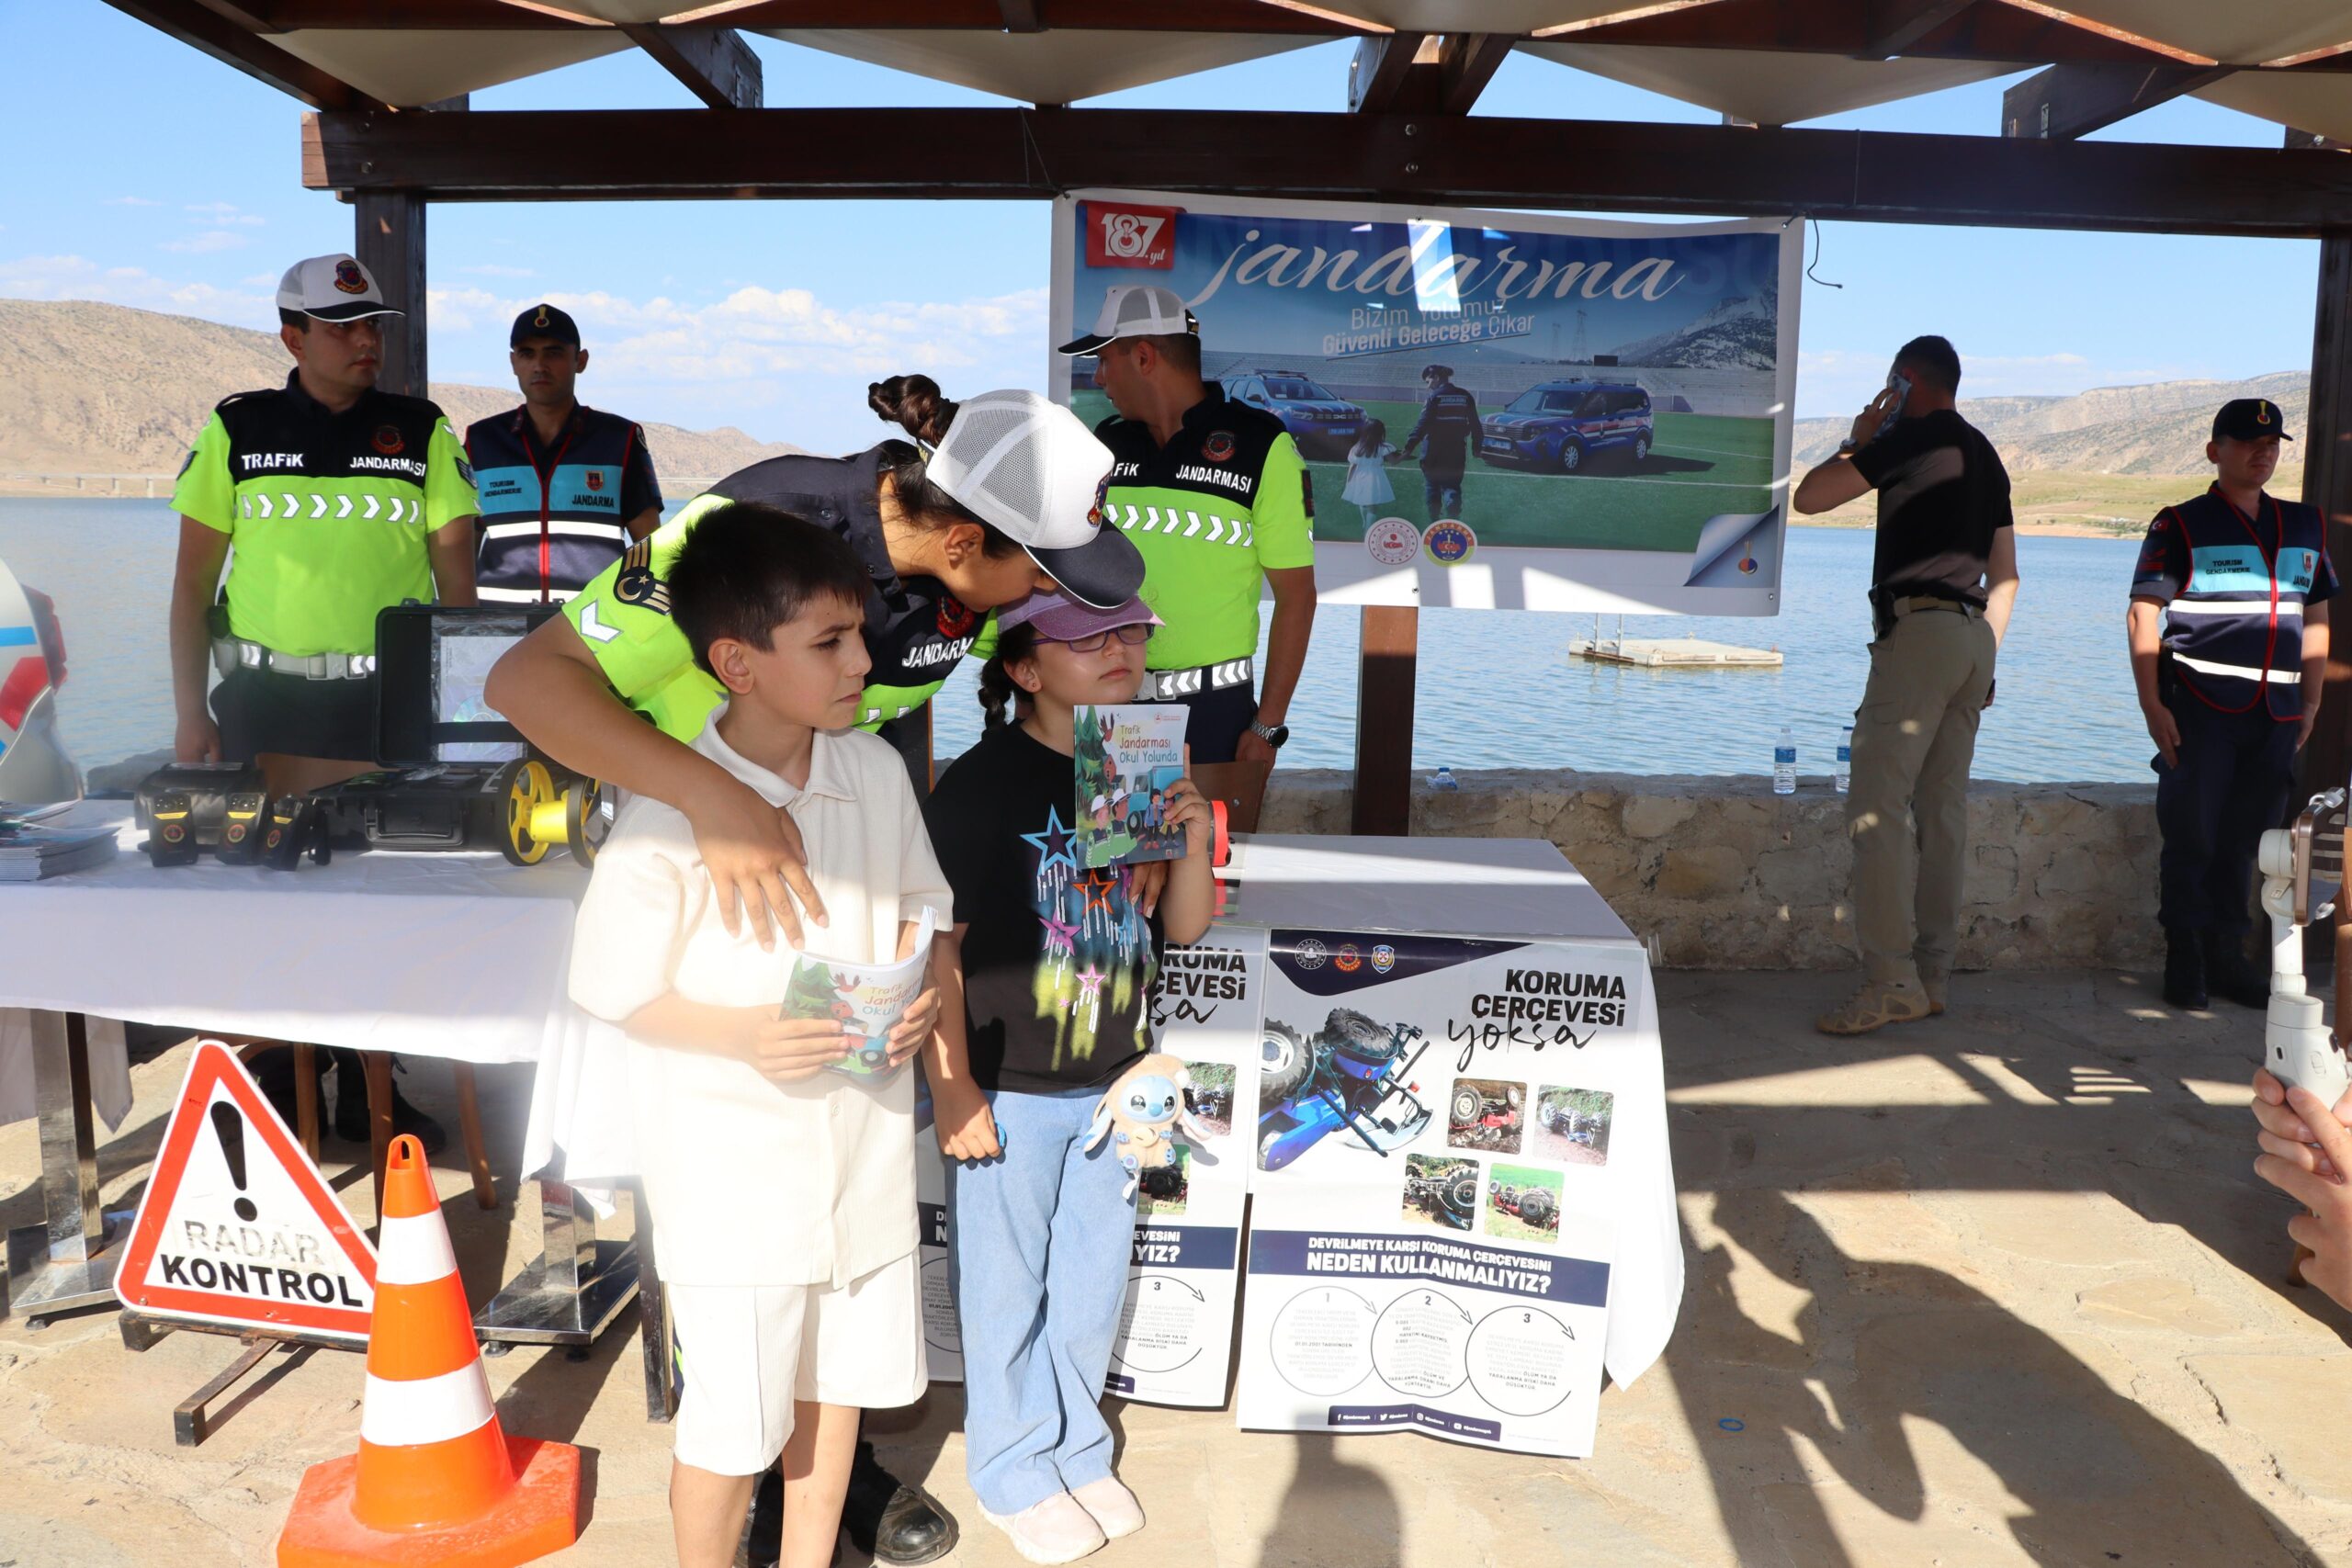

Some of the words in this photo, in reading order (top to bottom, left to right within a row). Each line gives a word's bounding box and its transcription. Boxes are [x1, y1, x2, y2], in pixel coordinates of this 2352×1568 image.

[1186, 220, 1685, 308] jandarma
[1351, 305, 1408, 330] Bizim
[1420, 299, 1508, 321] Yolumuz
[1323, 330, 1391, 355] Güvenli
[1398, 319, 1481, 346] Geleceğe
[1488, 313, 1535, 339] Çıkar
[349, 457, 426, 477] JANDARMASI
[1175, 464, 1252, 493] JANDARMASI
[571, 494, 615, 507] JANDARMA
[1119, 737, 1171, 749] Jandarması
[1120, 725, 1141, 735] Trafik
[1119, 751, 1139, 763] Okul
[1143, 750, 1178, 762] Yolunda
[1163, 943, 1246, 973] RUMA
[1505, 969, 1626, 999] KORUMA
[863, 1003, 897, 1015] Okul
[1471, 994, 1625, 1026] ÇERÇEVESİ
[1448, 1010, 1597, 1073] yoksa
[184, 1220, 325, 1266] RADAR
[1308, 1237, 1384, 1250] DEVRİLMEYE
[1385, 1239, 1420, 1253] KARŞI
[1422, 1241, 1471, 1260] KORUMA
[1473, 1250, 1552, 1272] ÇERÇEVESİNİ
[160, 1254, 364, 1307] KONTROL
[1154, 1281, 1161, 1292] 3
[1306, 1252, 1376, 1273] NEDEN
[1380, 1254, 1552, 1293] KULLANMALIYIZ?
[1325, 1292, 1330, 1303] 1
[1425, 1295, 1431, 1306] 2
[1523, 1313, 1531, 1324] 3
